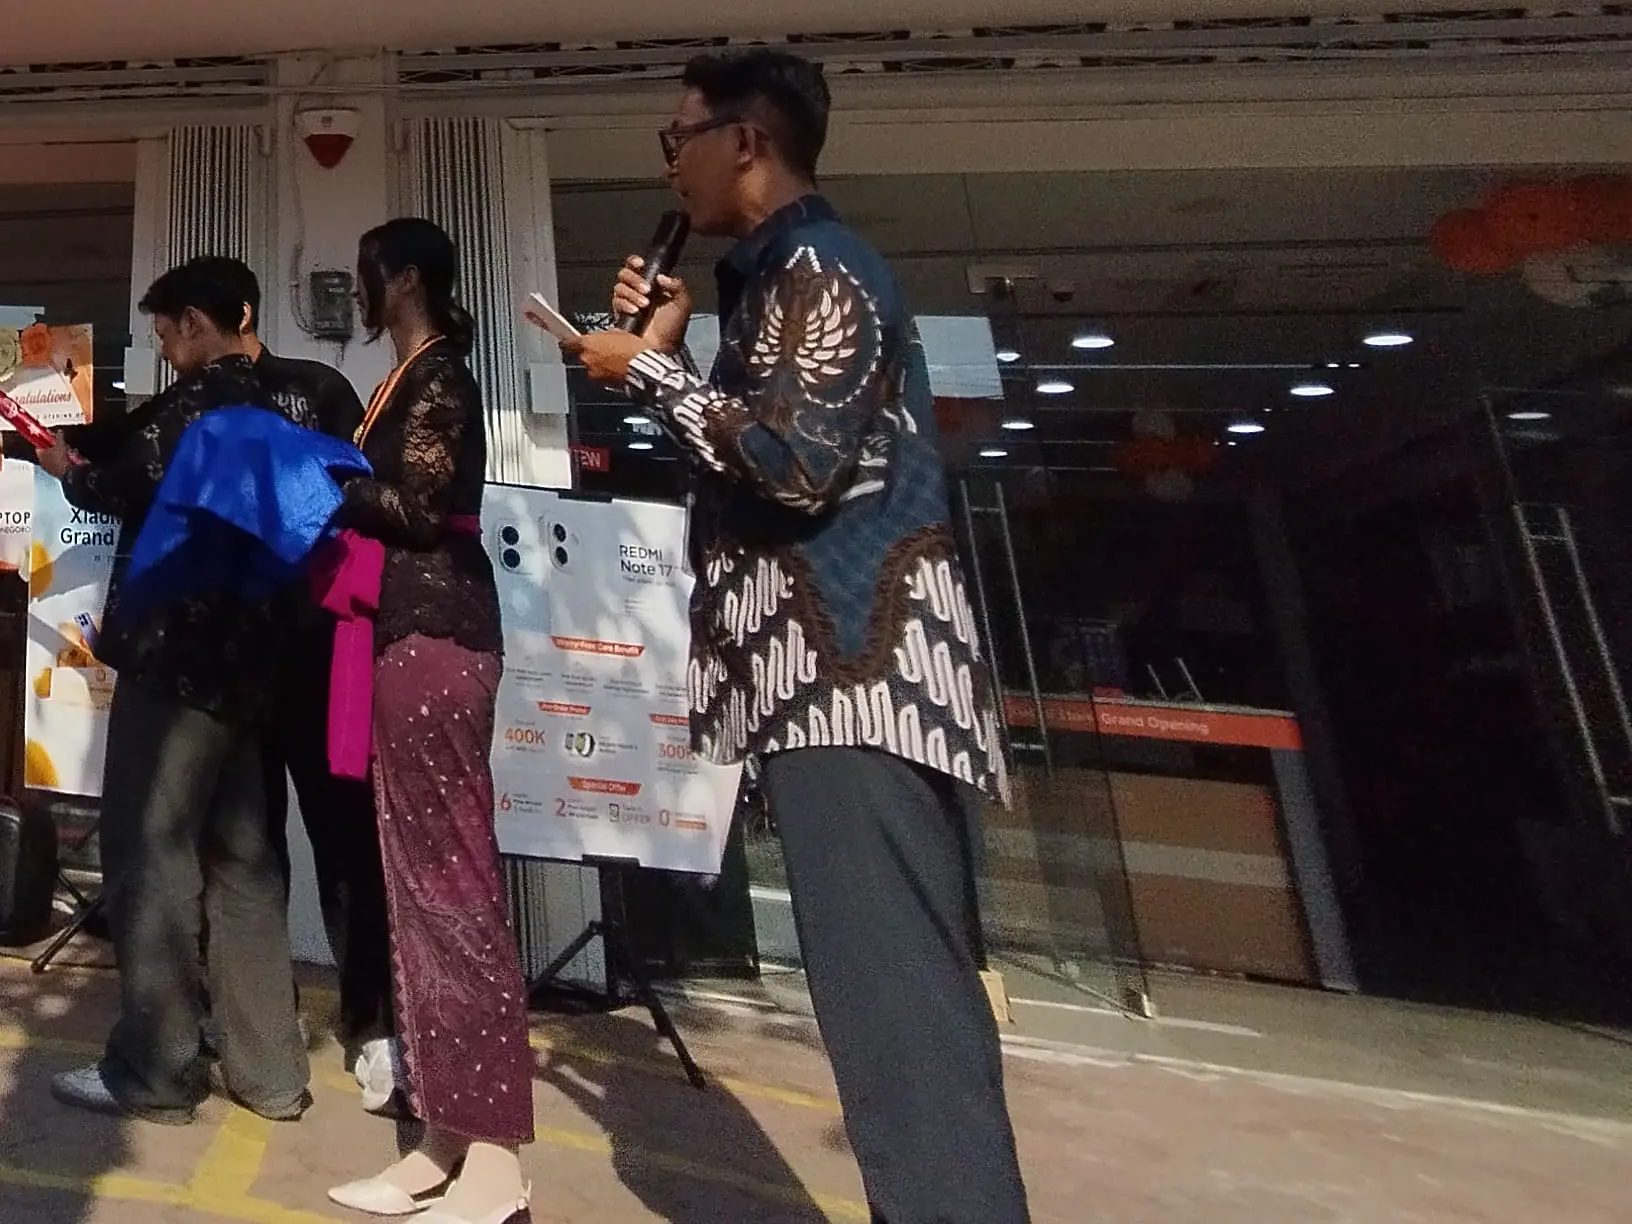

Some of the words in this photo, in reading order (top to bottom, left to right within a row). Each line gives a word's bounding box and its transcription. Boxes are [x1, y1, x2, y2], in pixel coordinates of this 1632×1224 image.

[16, 389, 72, 405] atulations
[60, 527, 114, 546] Grand
[619, 544, 663, 562] REDMI
[620, 559, 656, 576] Note
[1101, 712, 1144, 727] Grand
[1147, 716, 1210, 735] Opening
[504, 728, 546, 745] 400K
[555, 797, 567, 817] 2
